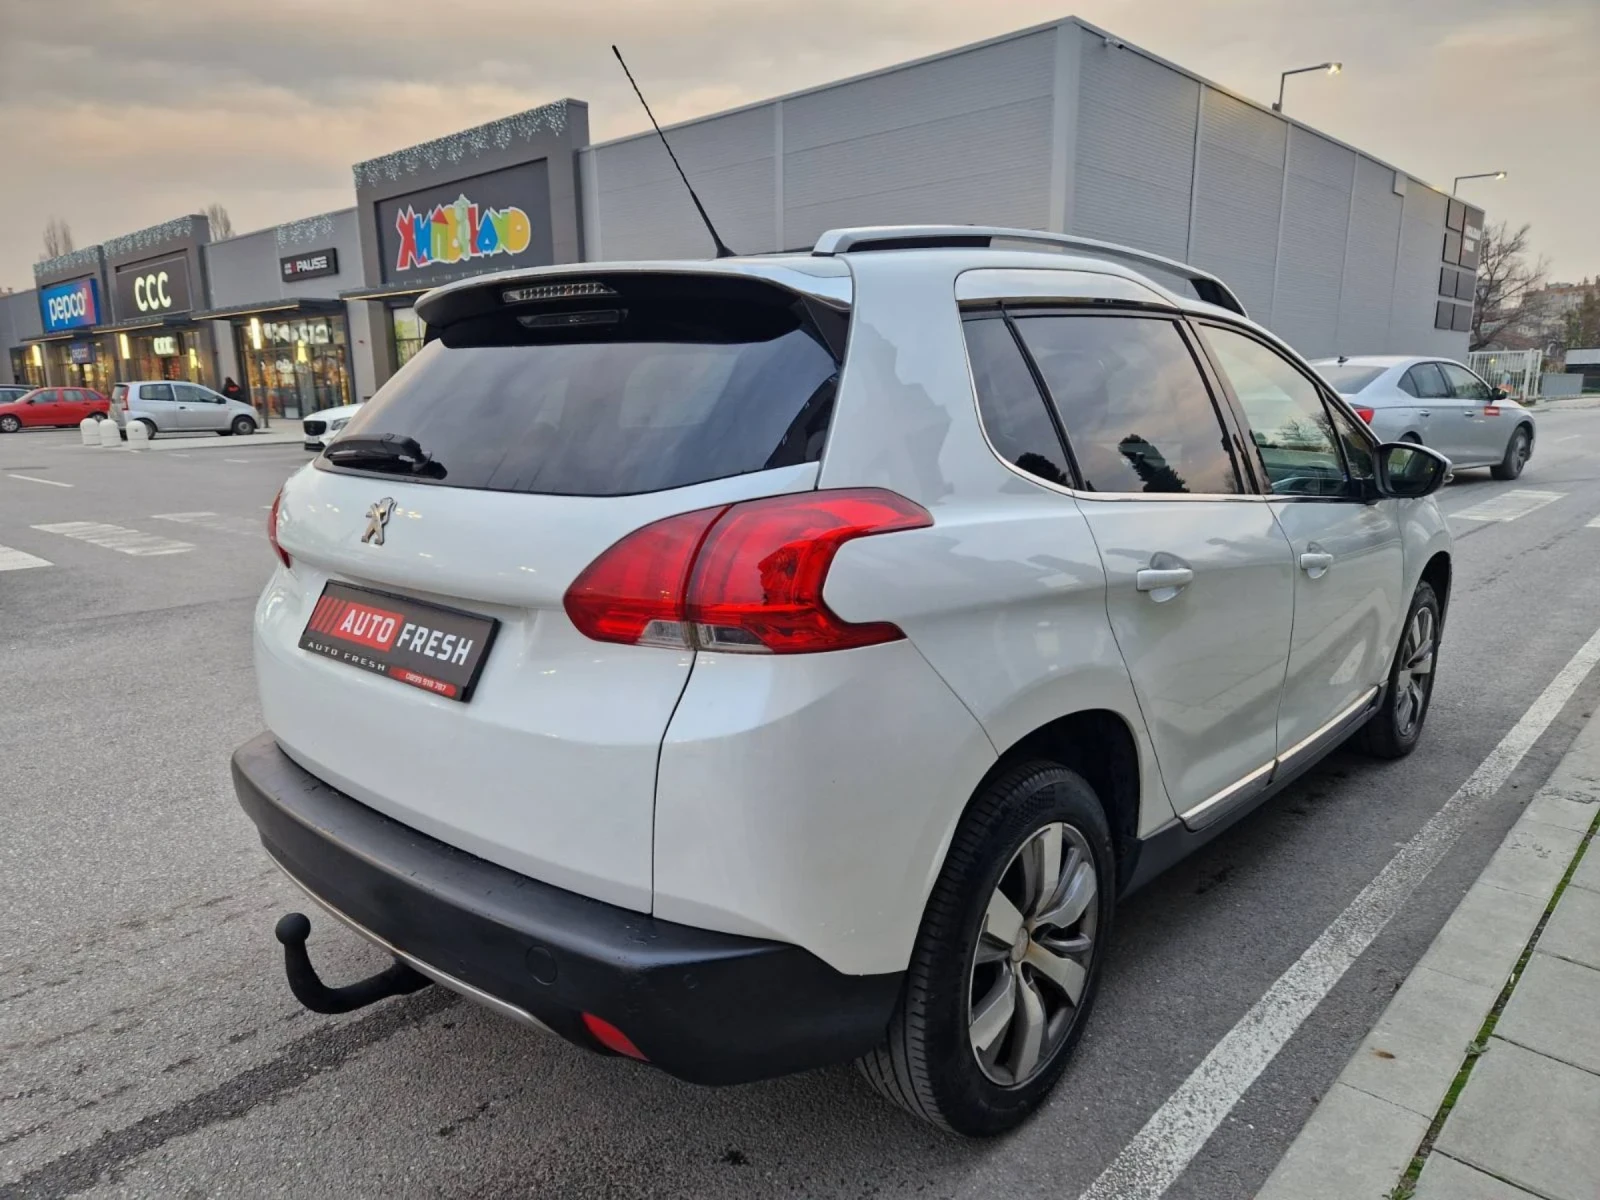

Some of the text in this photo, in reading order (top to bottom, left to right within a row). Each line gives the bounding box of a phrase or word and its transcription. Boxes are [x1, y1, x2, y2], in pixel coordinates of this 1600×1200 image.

[296, 256, 328, 272] PAUSE
[48, 291, 86, 327] pepco
[134, 271, 172, 312] CCC
[340, 609, 474, 666] AUTO FRESH
[307, 641, 386, 671] AUTO FRESH
